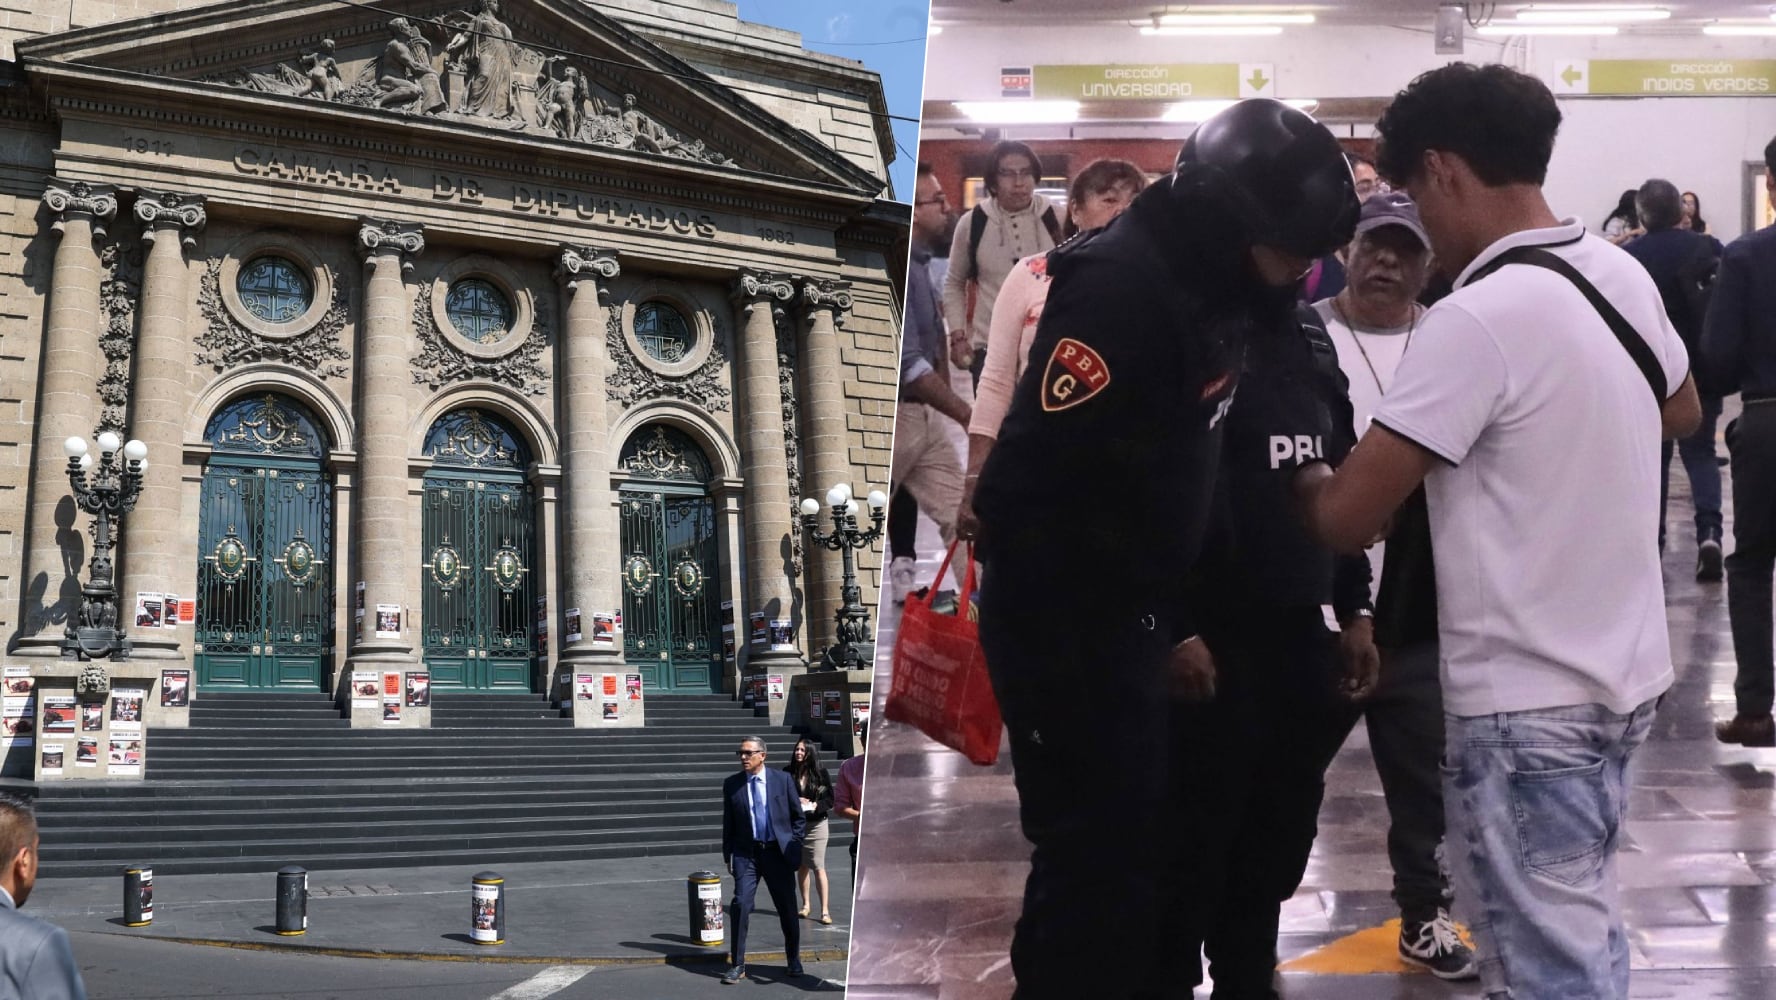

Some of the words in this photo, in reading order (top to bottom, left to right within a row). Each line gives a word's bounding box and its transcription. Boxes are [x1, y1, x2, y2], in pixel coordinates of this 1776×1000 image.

[1082, 83, 1192, 97] UNIVERSIDAD
[1643, 78, 1694, 91] INDIOS
[1703, 78, 1769, 91] VERDES
[123, 136, 172, 157] 1911
[233, 150, 401, 194] CAMARA
[432, 173, 484, 206] DE
[512, 184, 717, 239] DIPUTADOS
[1061, 344, 1104, 383] PBI
[1053, 374, 1077, 400] G
